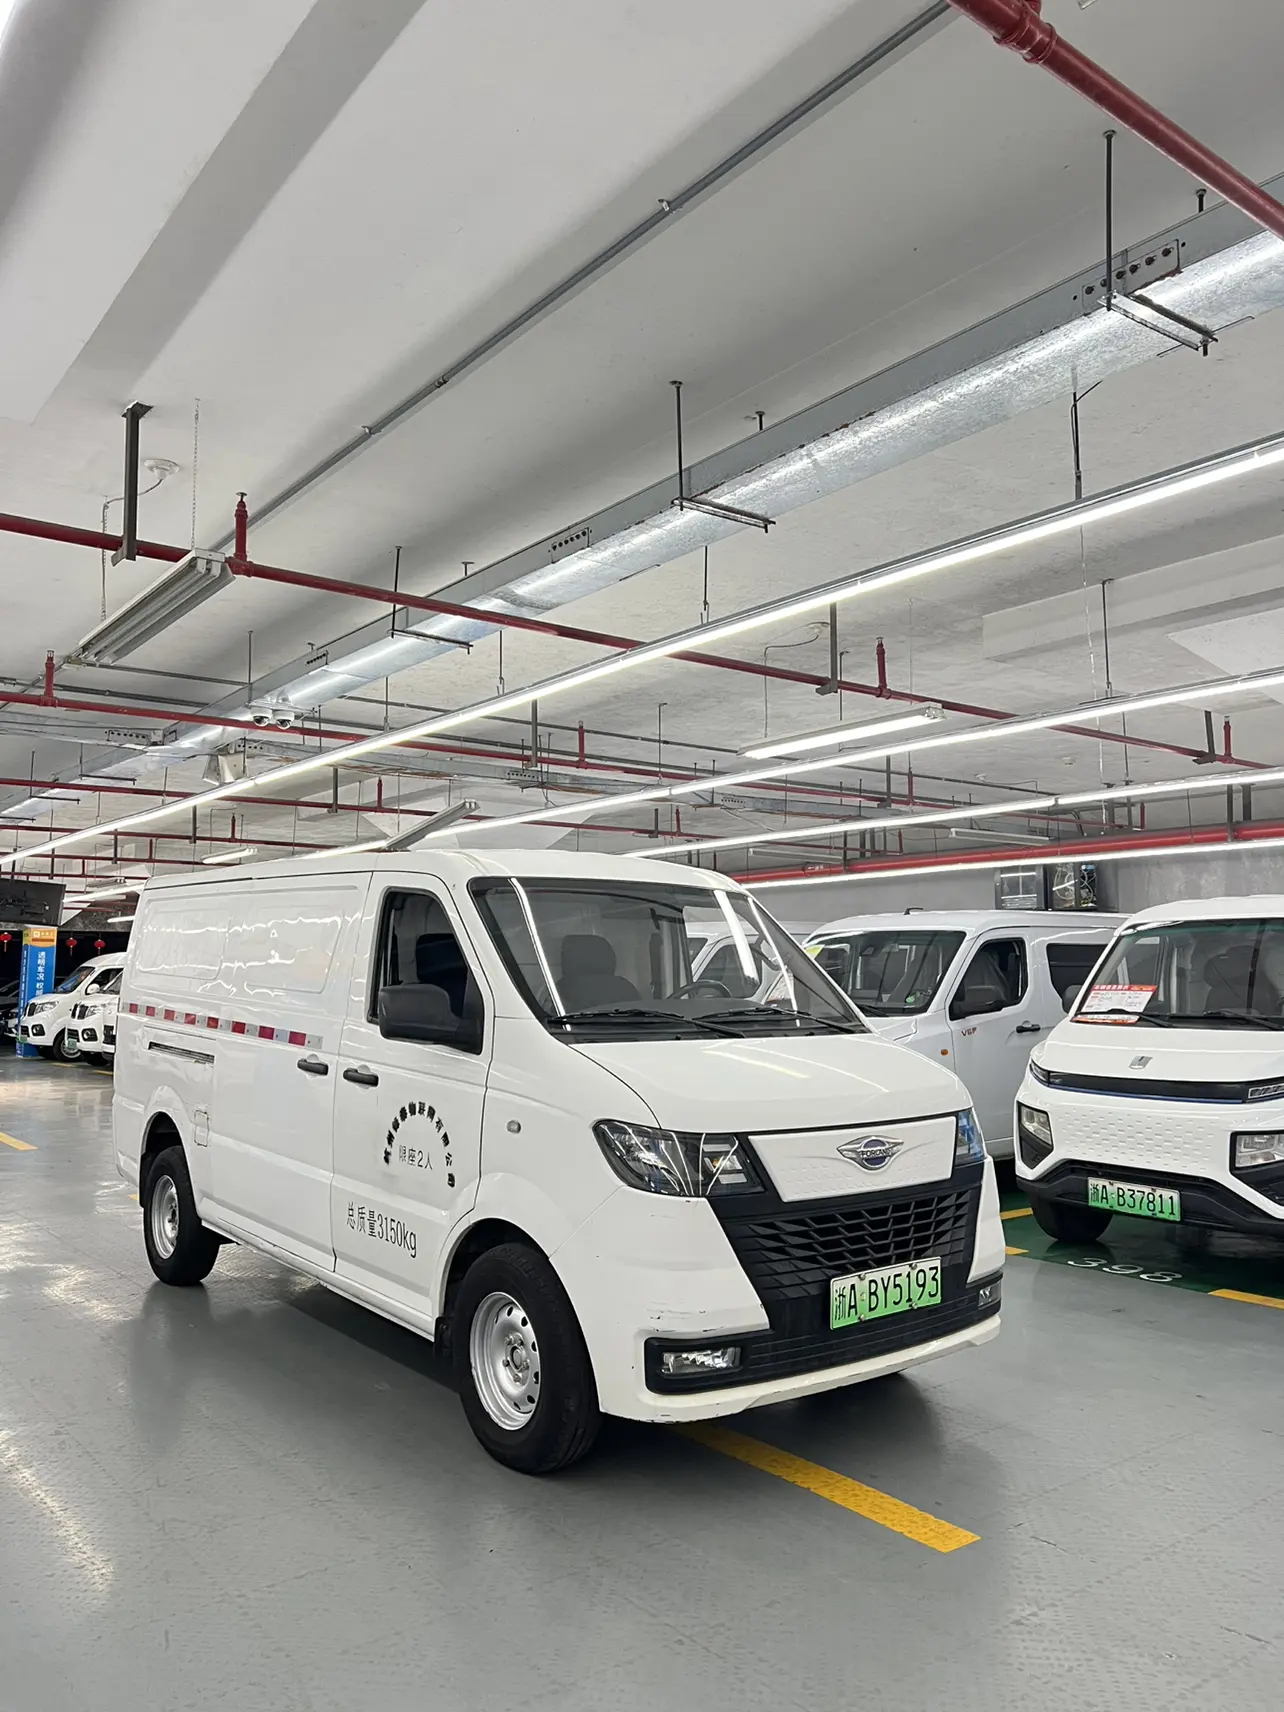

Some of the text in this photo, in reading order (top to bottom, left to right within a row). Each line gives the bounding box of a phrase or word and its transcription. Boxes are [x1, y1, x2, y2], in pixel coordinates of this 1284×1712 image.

[399, 1144, 433, 1170] 限座2人
[346, 1201, 417, 1258] 总质量3150kg
[1067, 1257, 1183, 1282] 398
